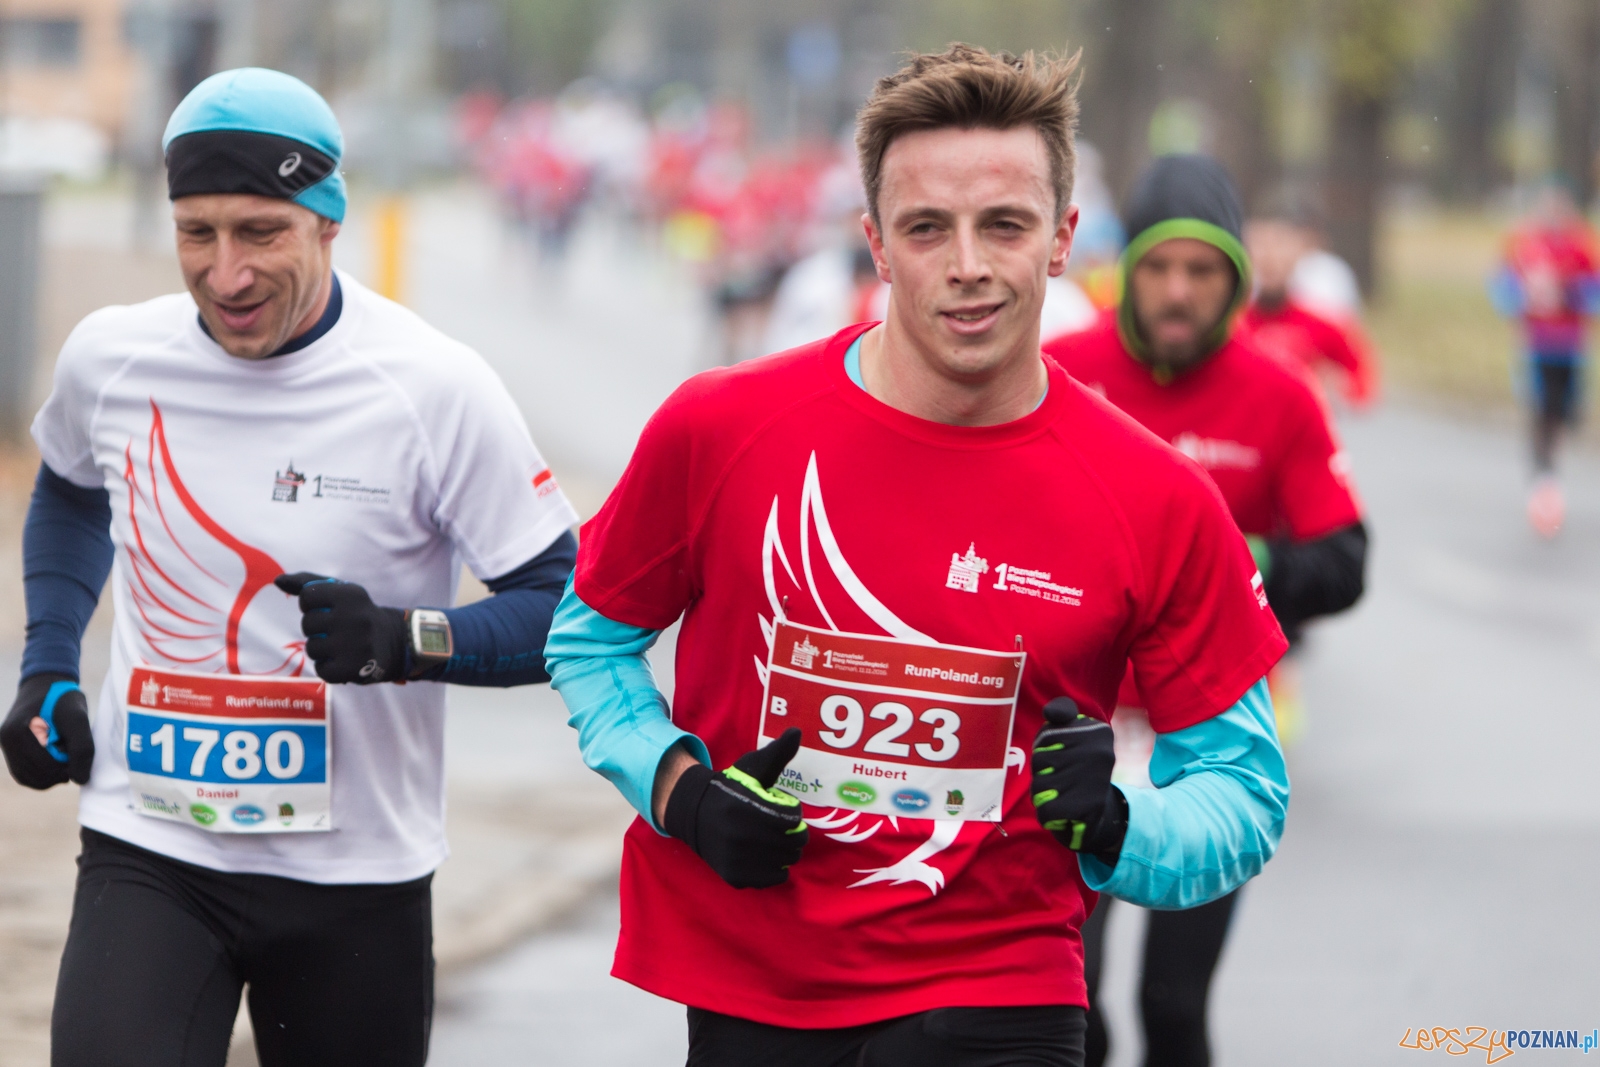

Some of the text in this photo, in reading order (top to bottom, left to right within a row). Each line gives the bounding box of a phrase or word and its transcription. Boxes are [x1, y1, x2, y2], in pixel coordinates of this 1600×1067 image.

[993, 563, 1008, 591] 1
[822, 649, 834, 669] 1
[904, 663, 1005, 689] RunPoland.org
[225, 694, 314, 712] RunPoland.org
[770, 695, 788, 717] B
[817, 693, 963, 763] 923
[129, 733, 144, 753] E
[150, 723, 306, 780] 1780
[852, 762, 908, 782] Hubert
[196, 787, 240, 799] Daniel
